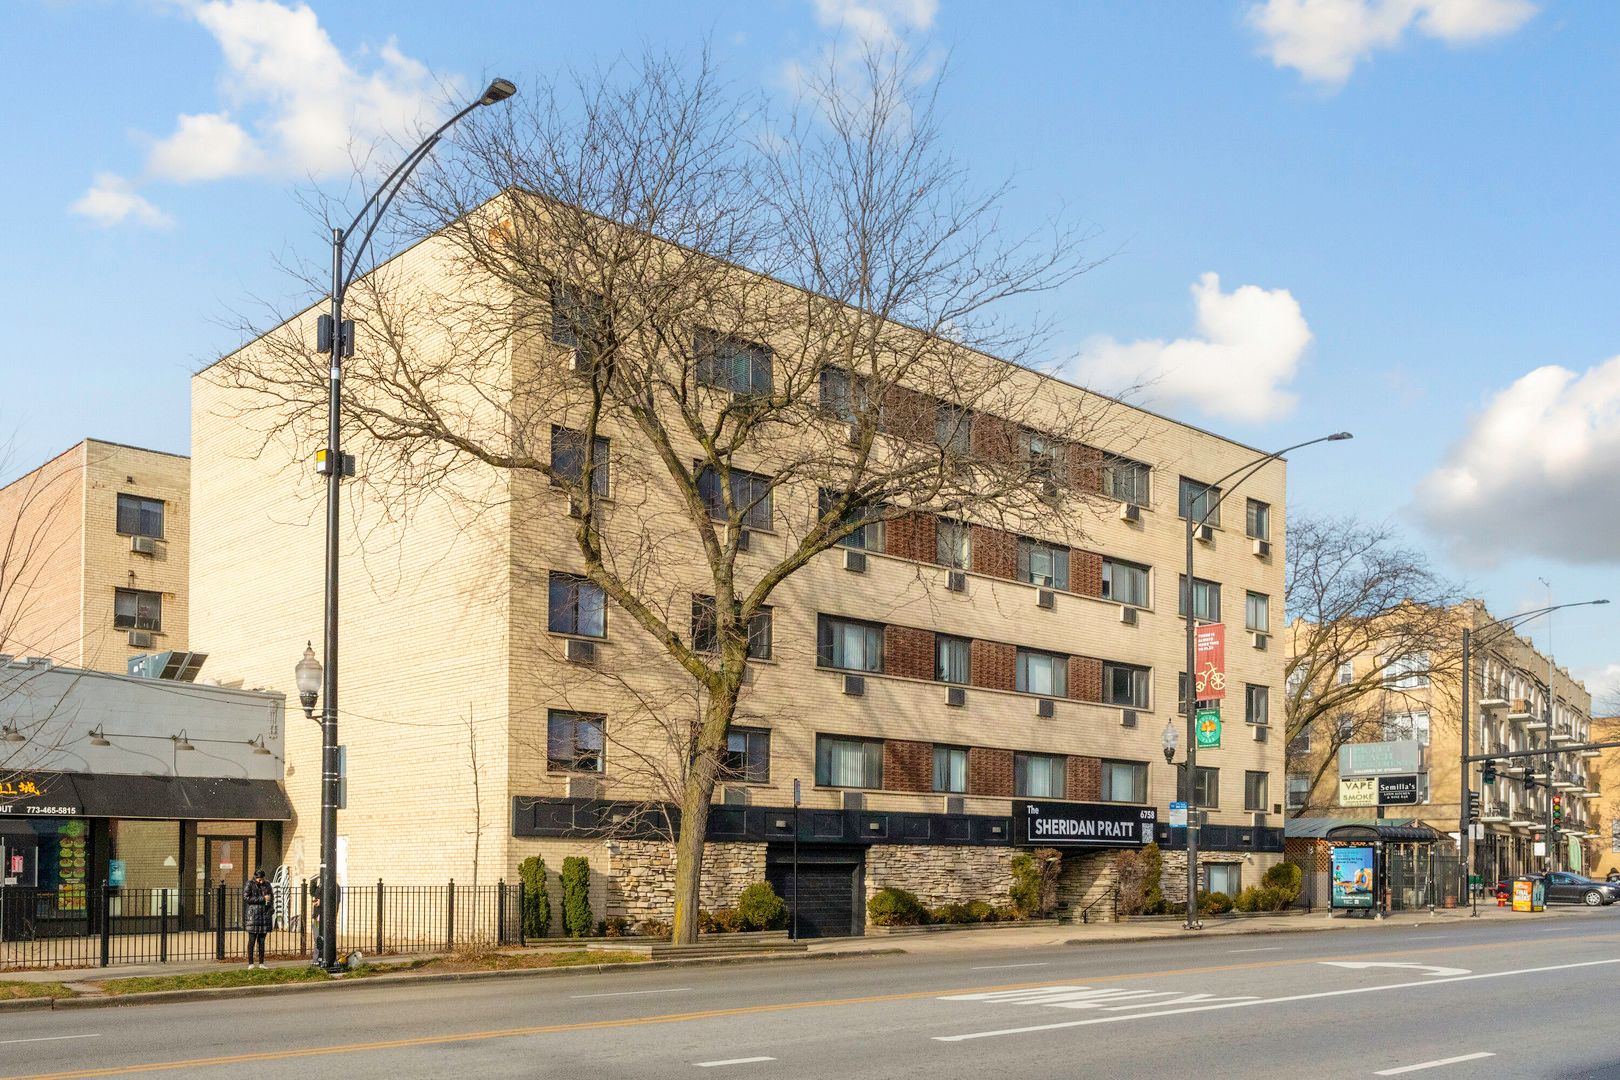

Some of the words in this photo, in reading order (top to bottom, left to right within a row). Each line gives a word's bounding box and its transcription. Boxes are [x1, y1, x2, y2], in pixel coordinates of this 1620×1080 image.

[1345, 782, 1373, 790] VAPE
[27, 806, 76, 814] 773-465-5815
[1027, 805, 1039, 814] The
[1140, 810, 1155, 819] 6758
[1035, 818, 1095, 836] SHERIDAN
[1098, 821, 1134, 837] PRATT
